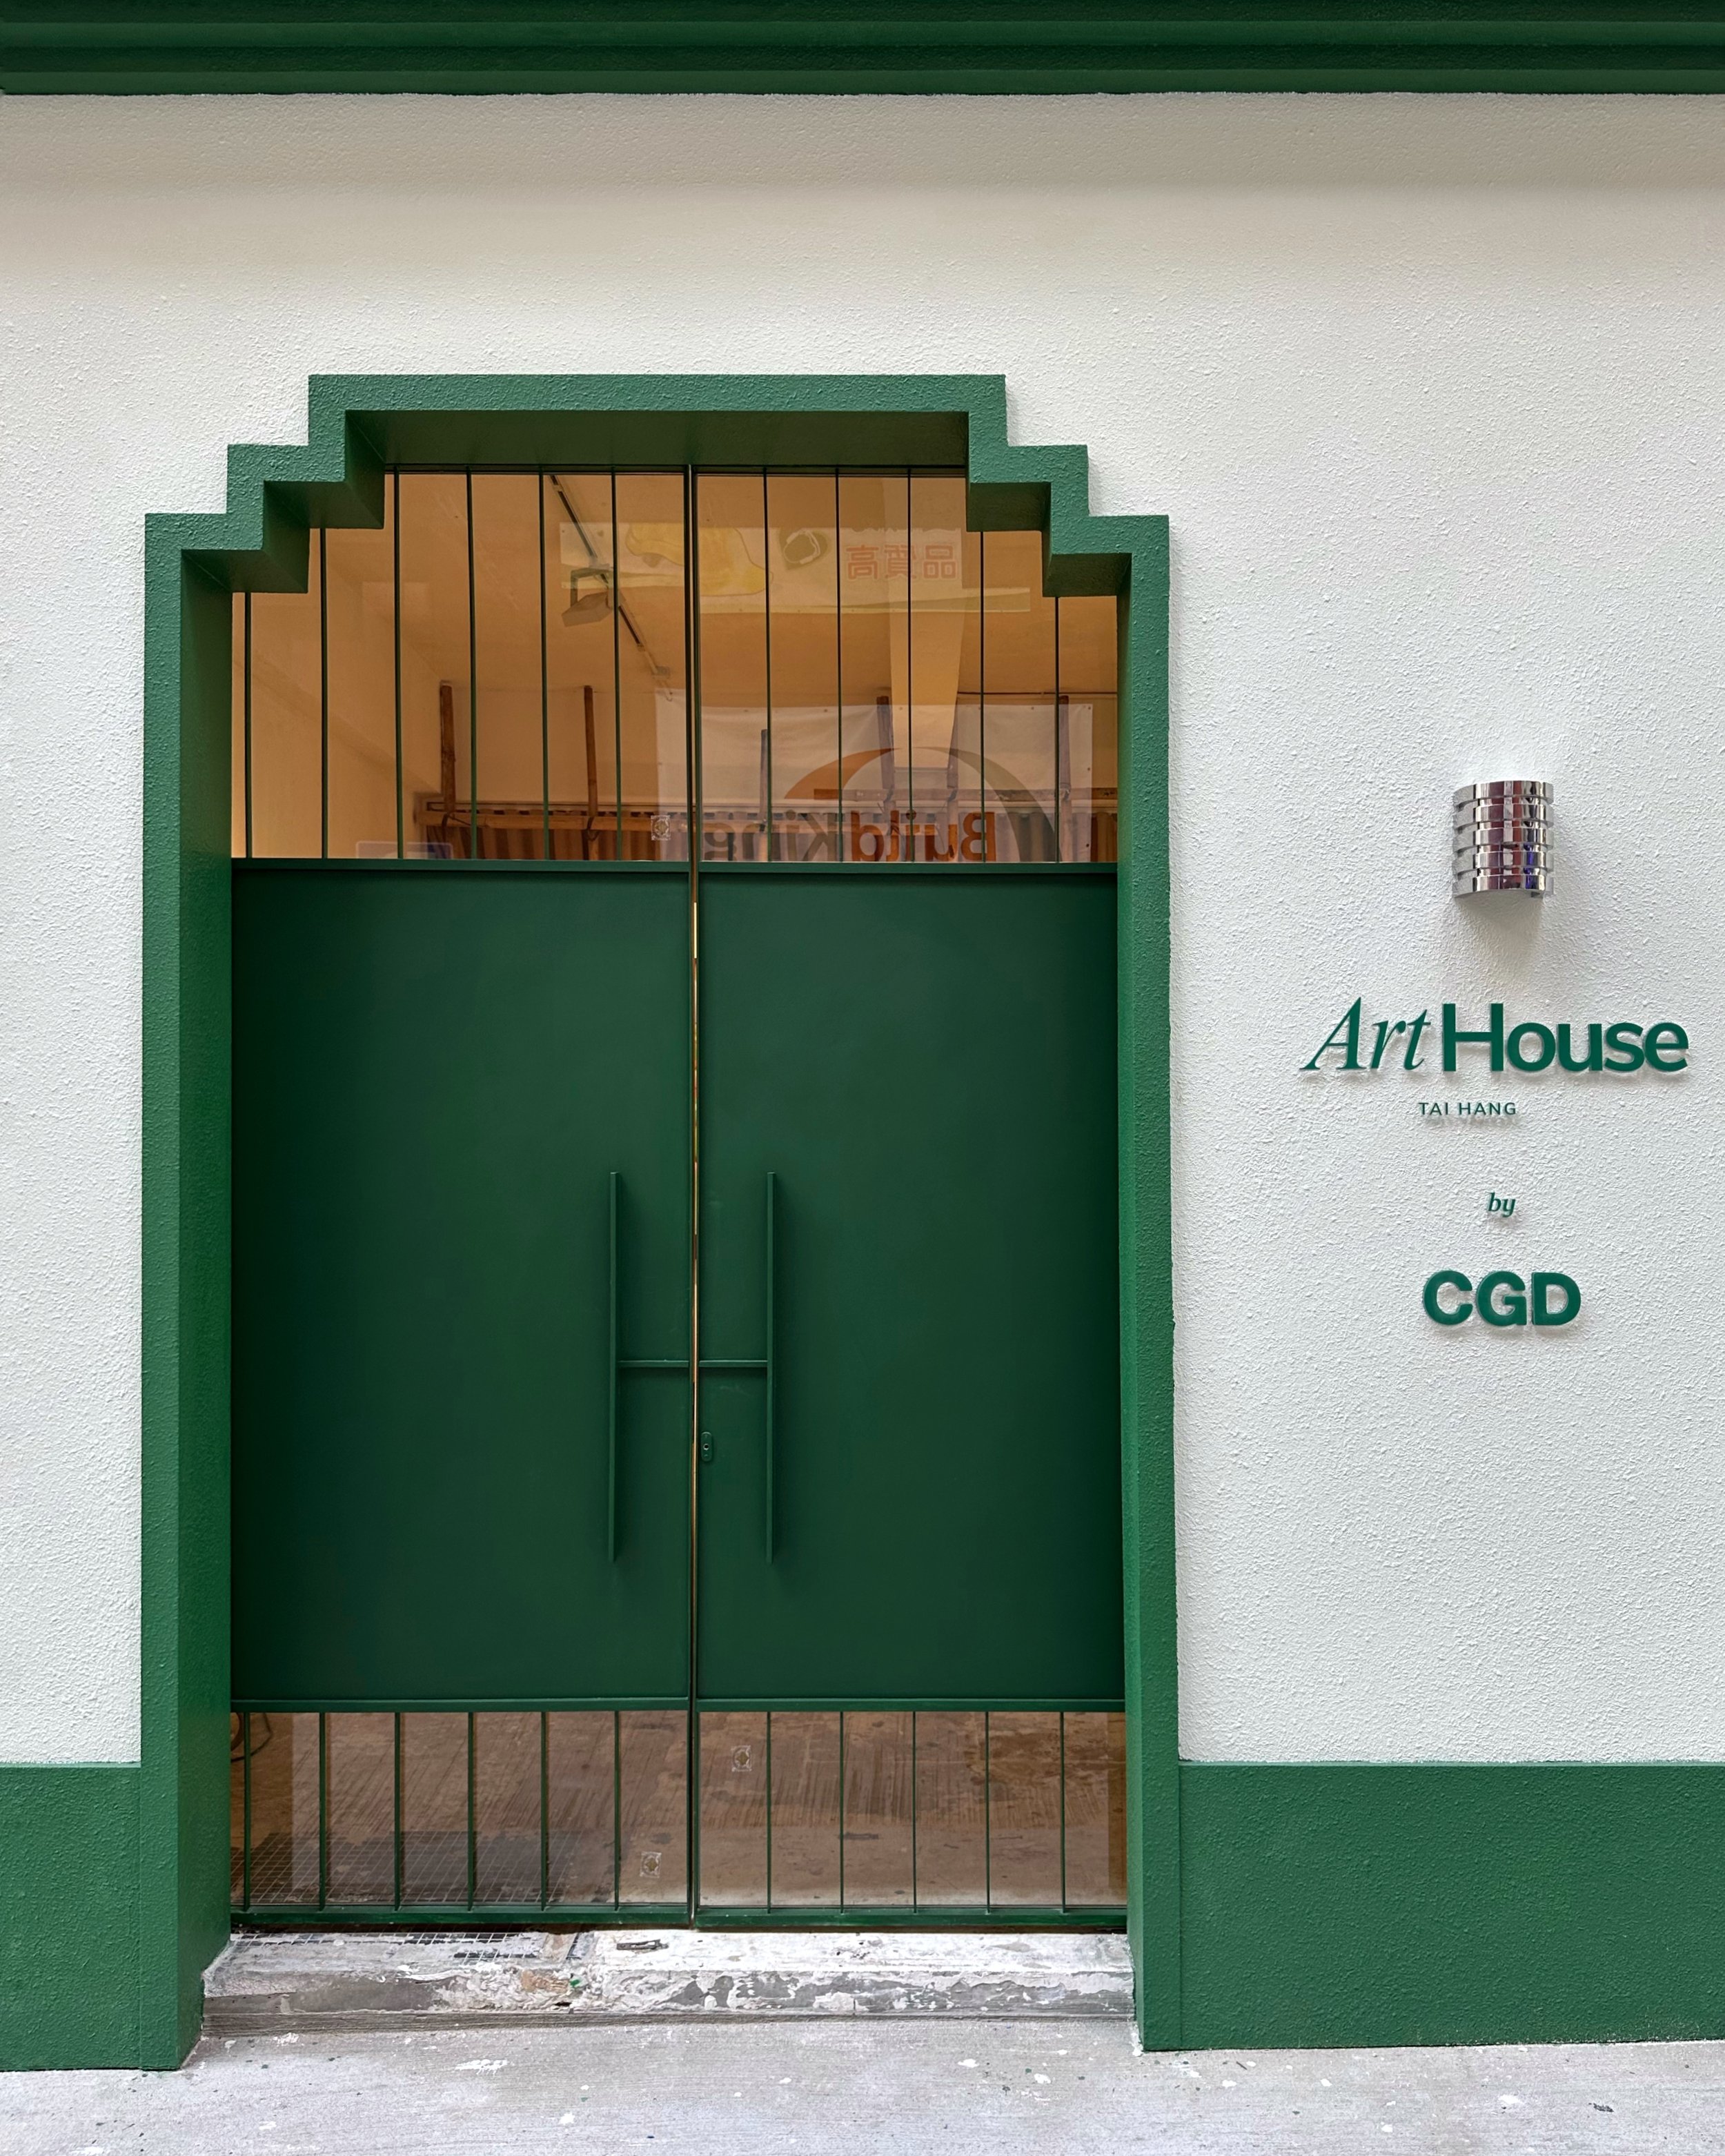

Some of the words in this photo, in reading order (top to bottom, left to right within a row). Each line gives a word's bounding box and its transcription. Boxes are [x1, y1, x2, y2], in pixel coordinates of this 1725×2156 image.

[1299, 997, 1431, 1071] Art
[1441, 1002, 1690, 1072] House
[1418, 1101, 1448, 1115] TAI
[1458, 1101, 1517, 1115] HANG
[1488, 1192, 1517, 1218] by
[1423, 1269, 1582, 1327] CGD
